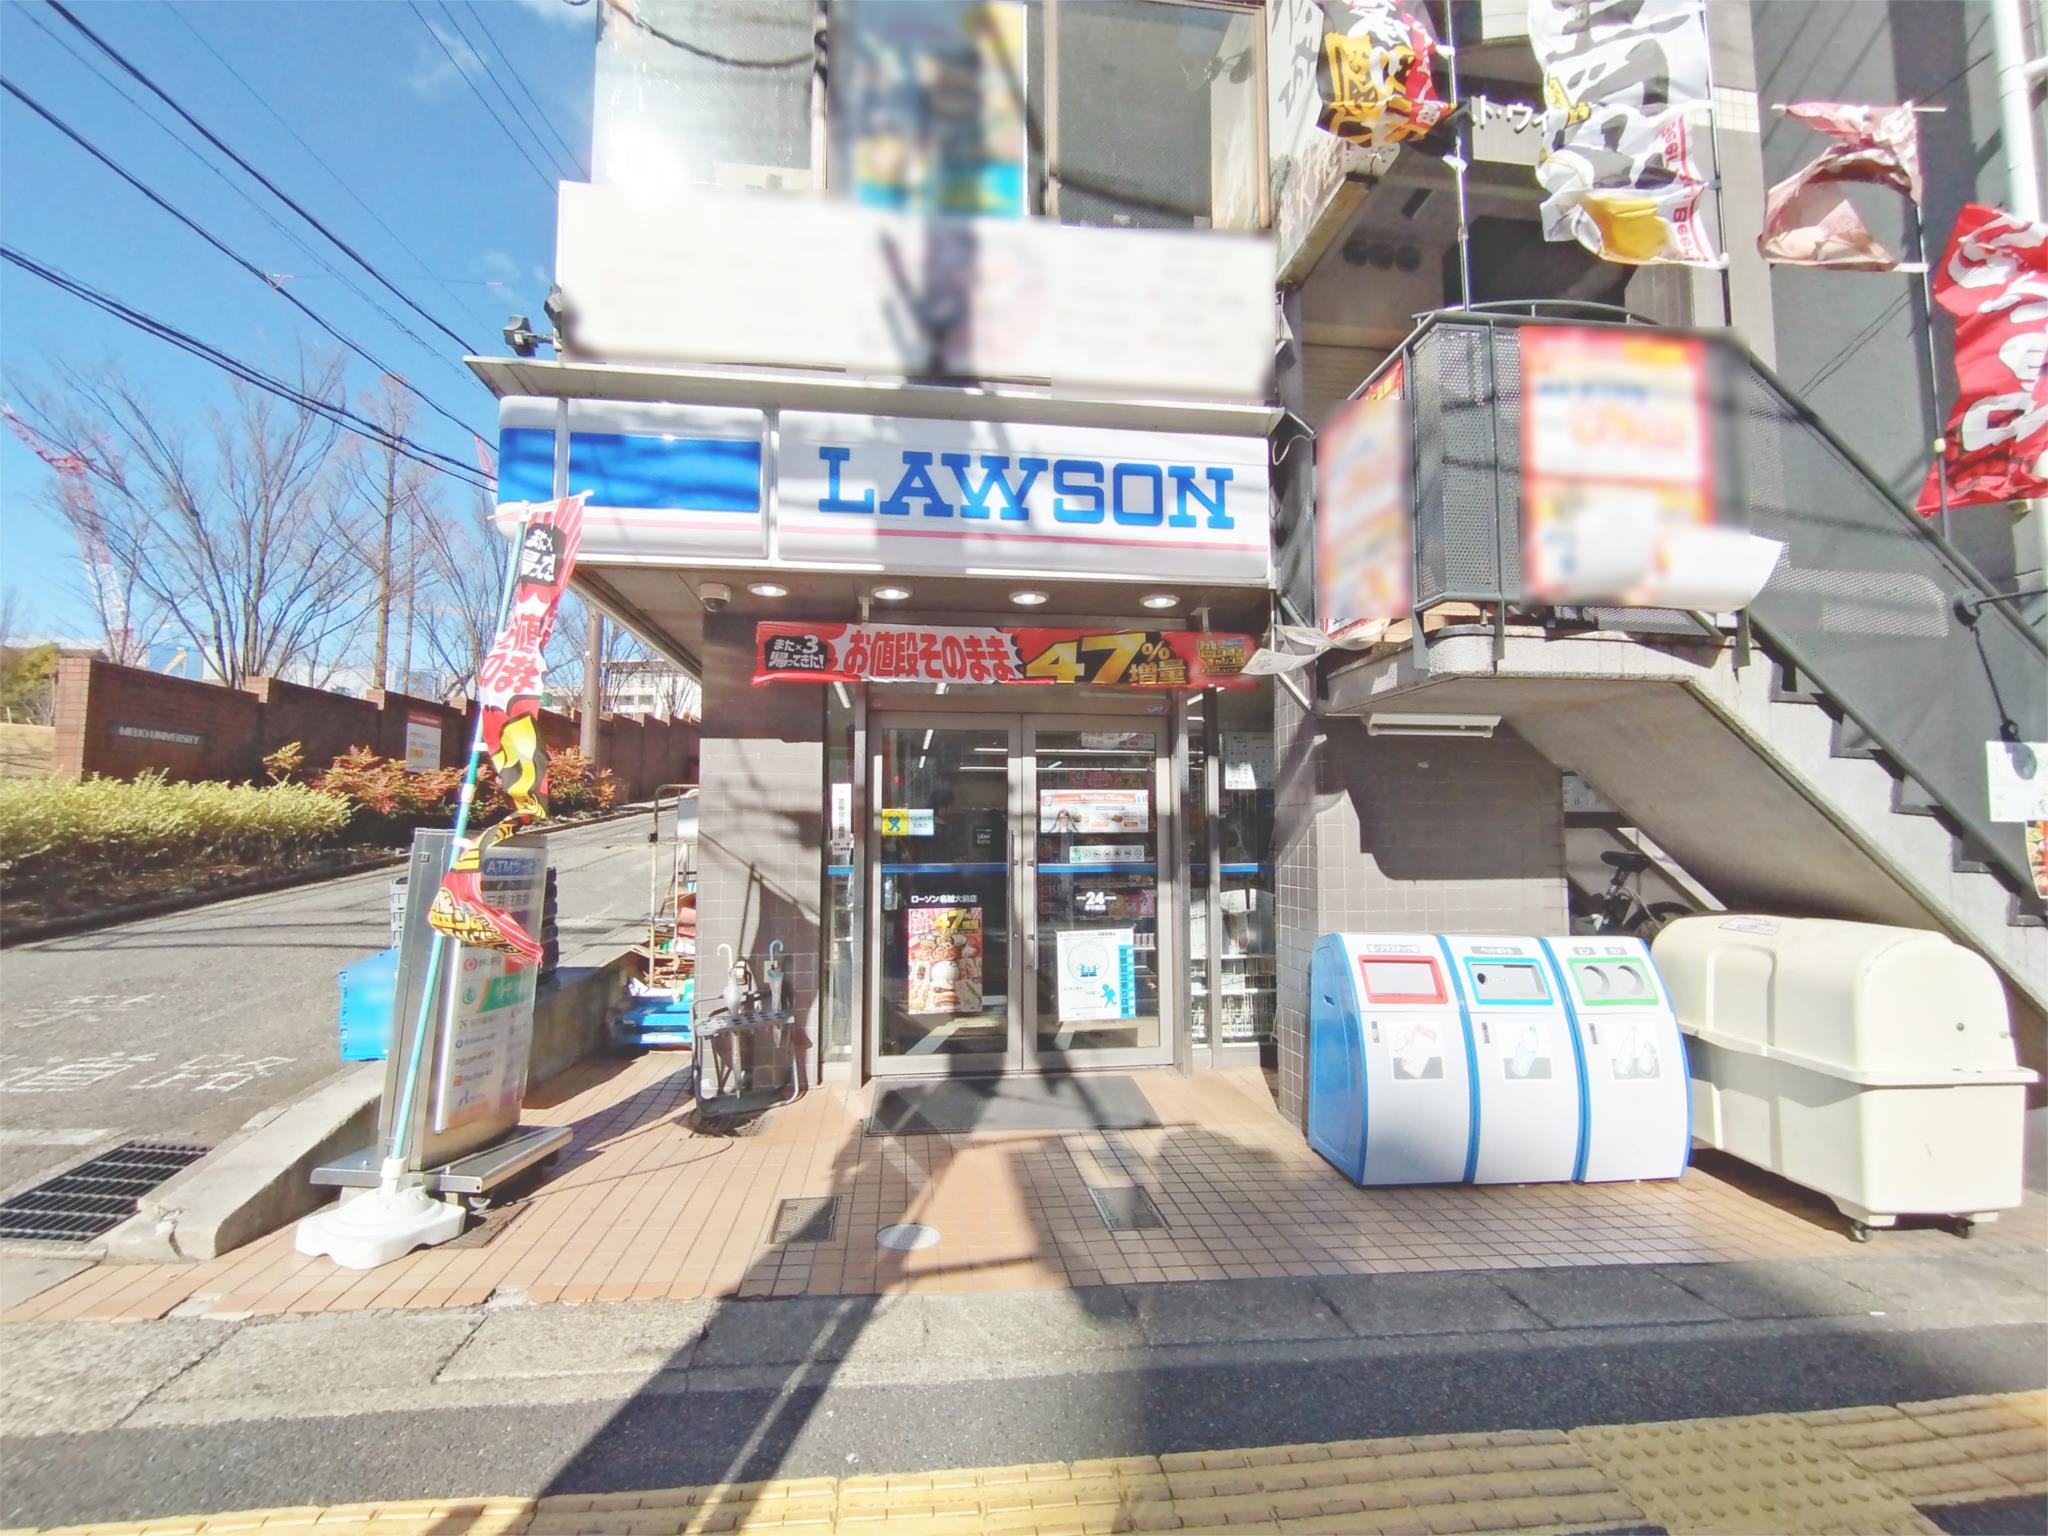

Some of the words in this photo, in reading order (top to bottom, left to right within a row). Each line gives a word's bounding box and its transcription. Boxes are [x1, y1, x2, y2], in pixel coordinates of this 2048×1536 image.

[818, 446, 1235, 529] LAWSON
[843, 630, 1014, 682] お値段そのまま
[1128, 659, 1188, 685] 増量
[150, 730, 200, 745] UNIVERSITY
[1086, 891, 1106, 905] 24
